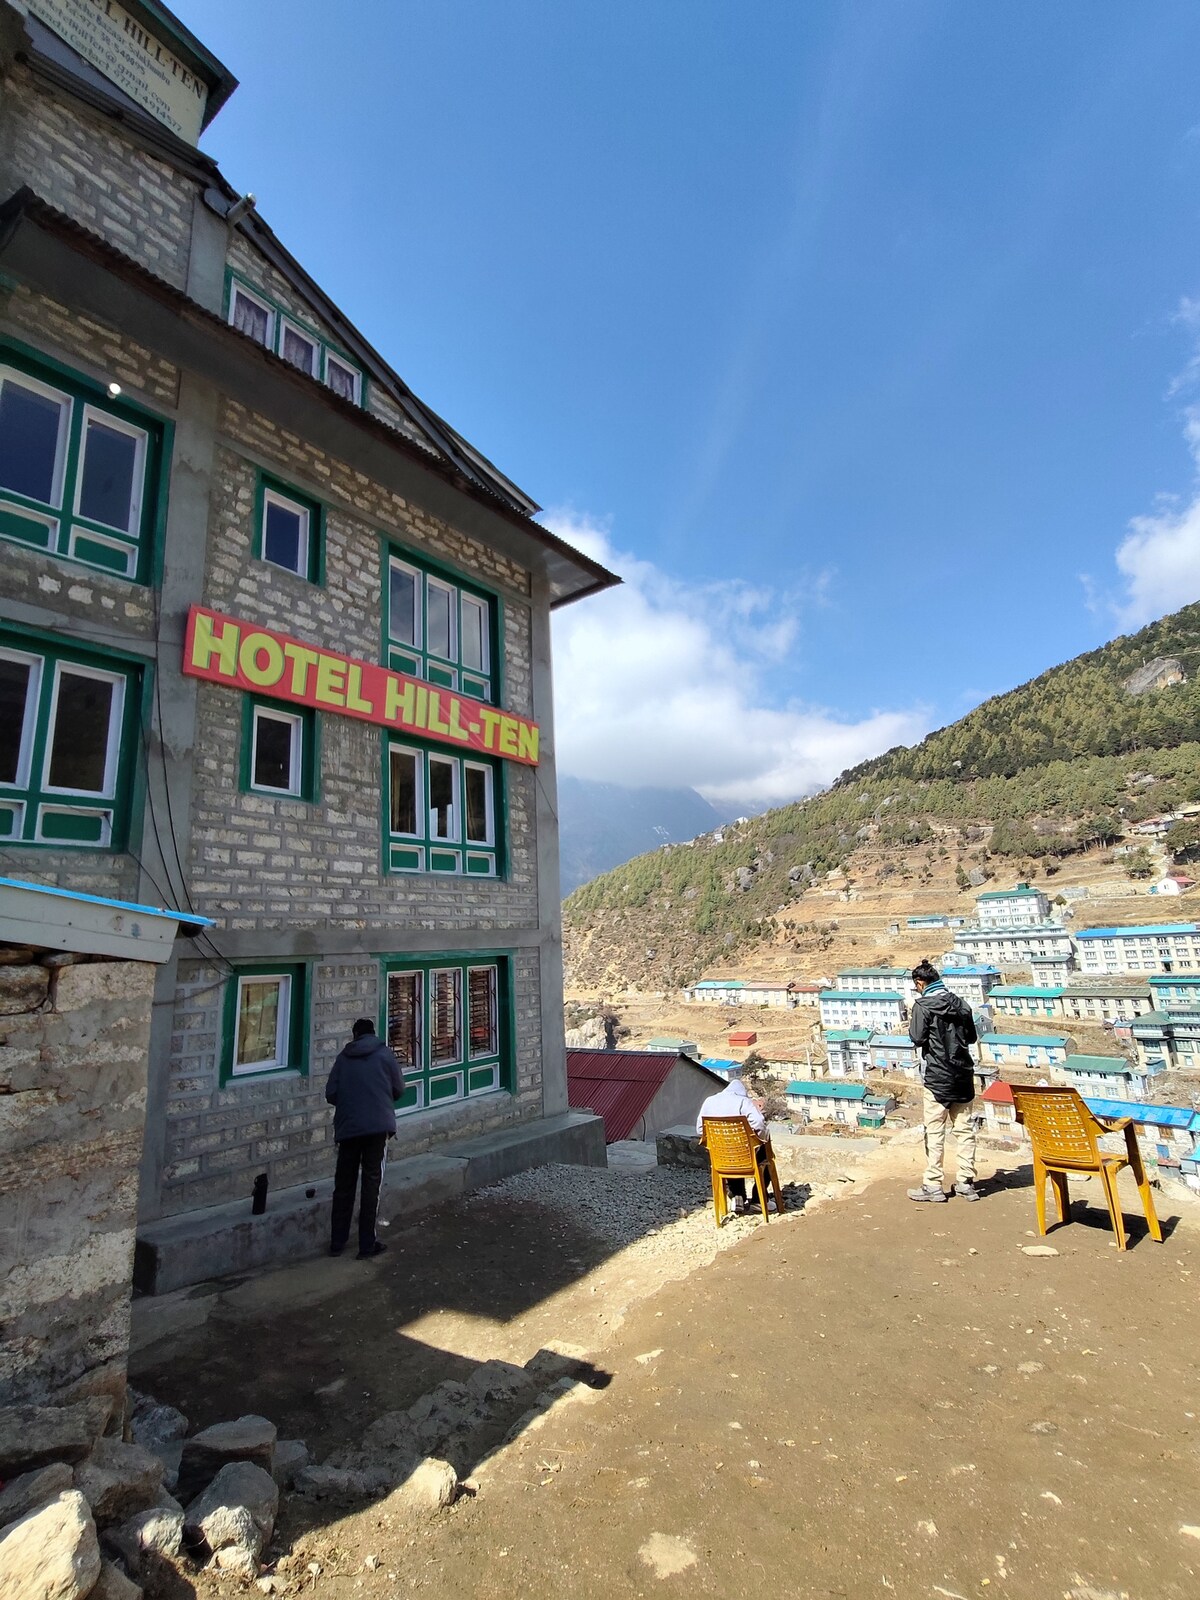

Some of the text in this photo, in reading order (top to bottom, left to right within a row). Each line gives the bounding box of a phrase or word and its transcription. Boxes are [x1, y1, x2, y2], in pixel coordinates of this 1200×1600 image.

[122, 15, 204, 100] HILL-TEN
[191, 612, 540, 763] HOTEL HILL-TEN
